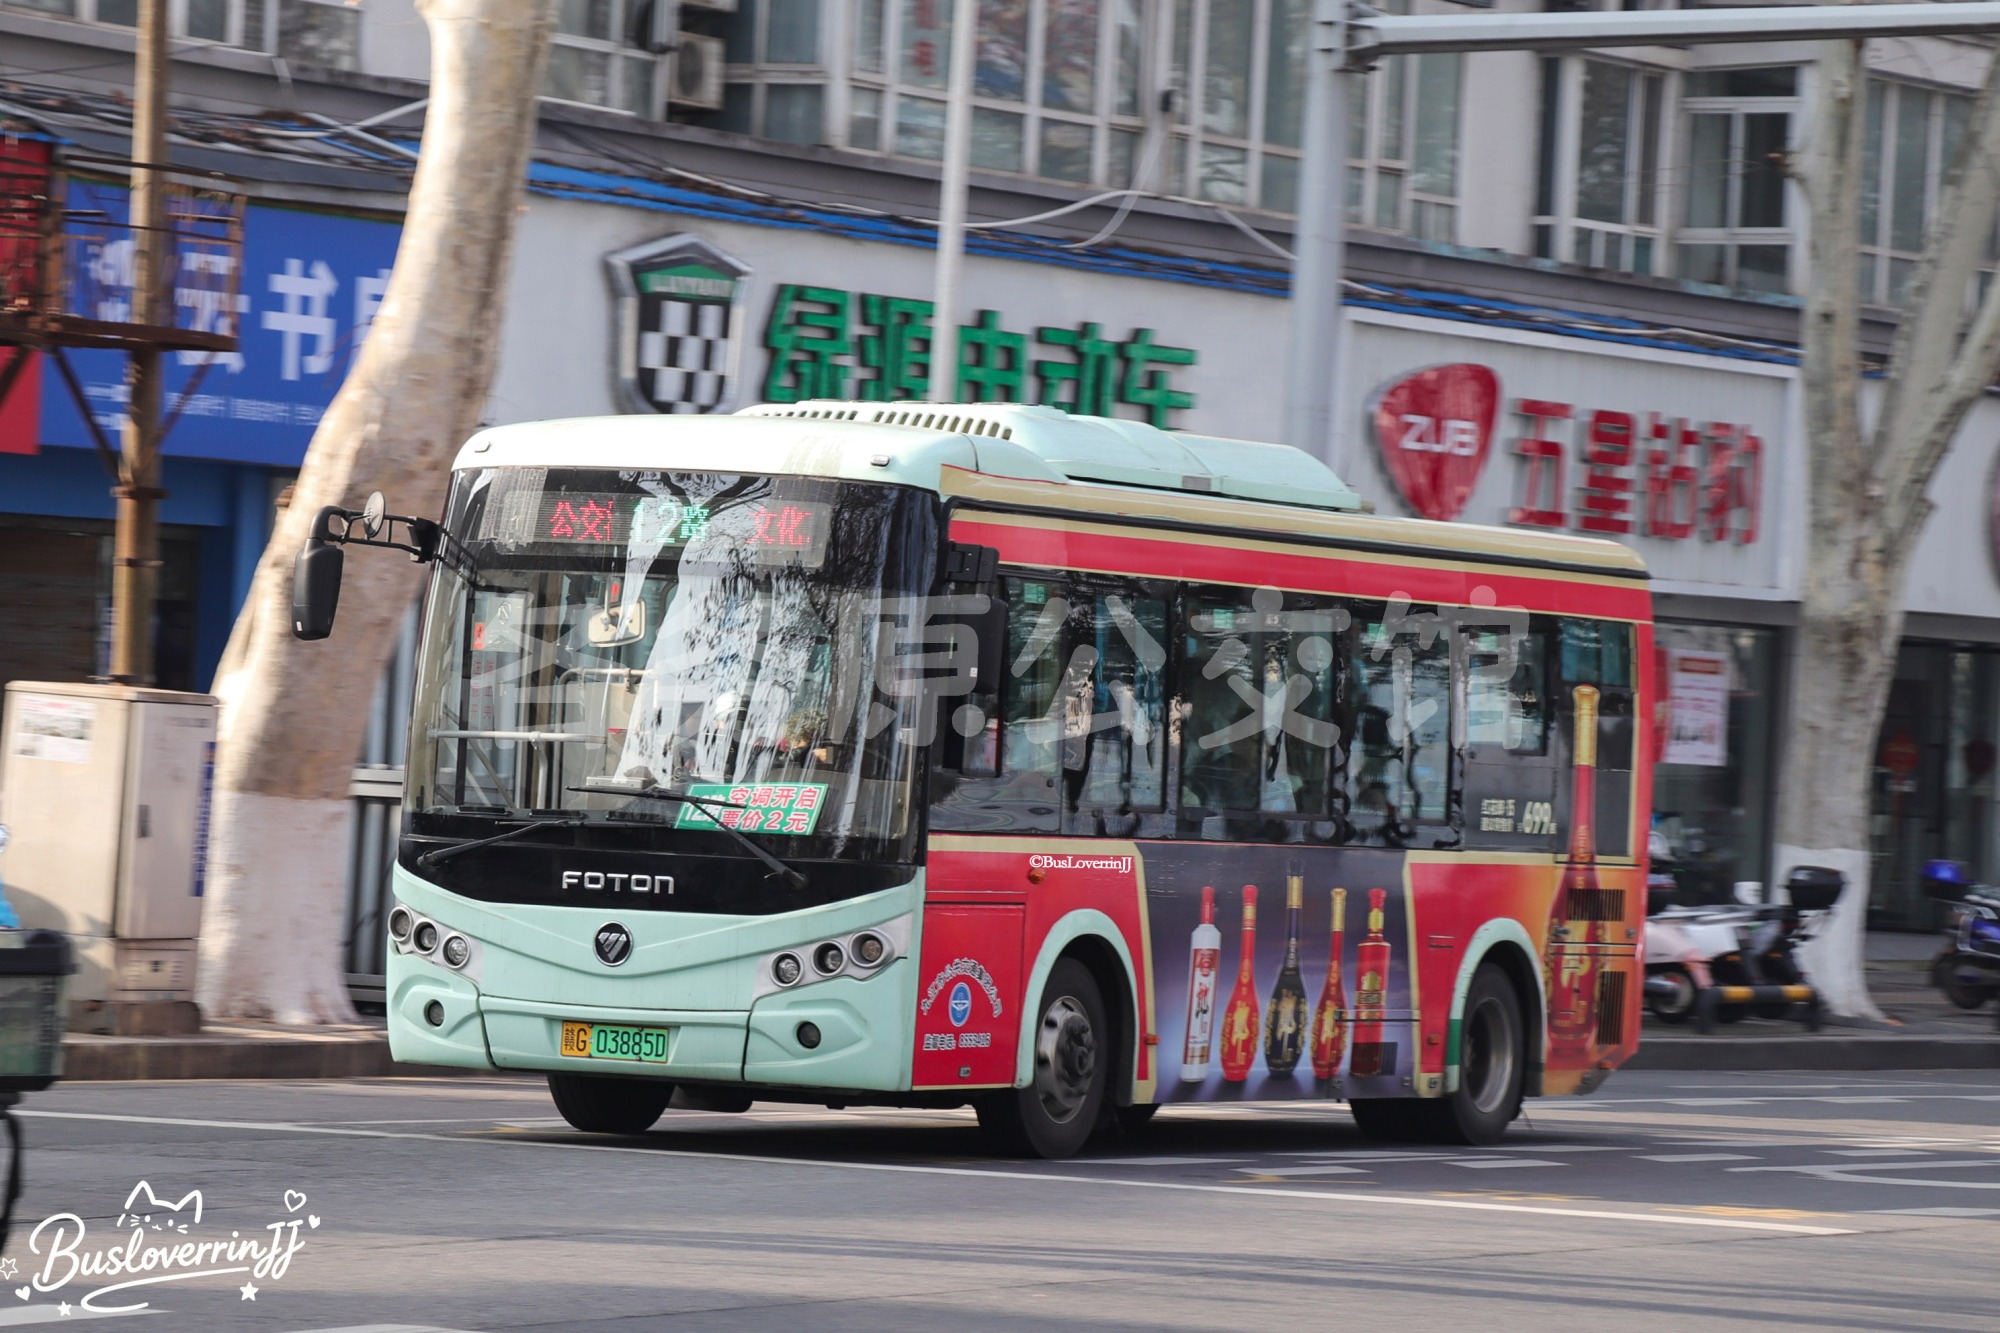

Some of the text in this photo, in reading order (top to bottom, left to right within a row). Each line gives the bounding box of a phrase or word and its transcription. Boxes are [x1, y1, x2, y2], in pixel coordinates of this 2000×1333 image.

[762, 283, 1198, 430] 绿源电动车
[549, 499, 614, 542] 公交
[729, 787, 819, 809] 空调开启
[717, 809, 809, 833] 票价2元
[562, 871, 675, 894] FOTON
